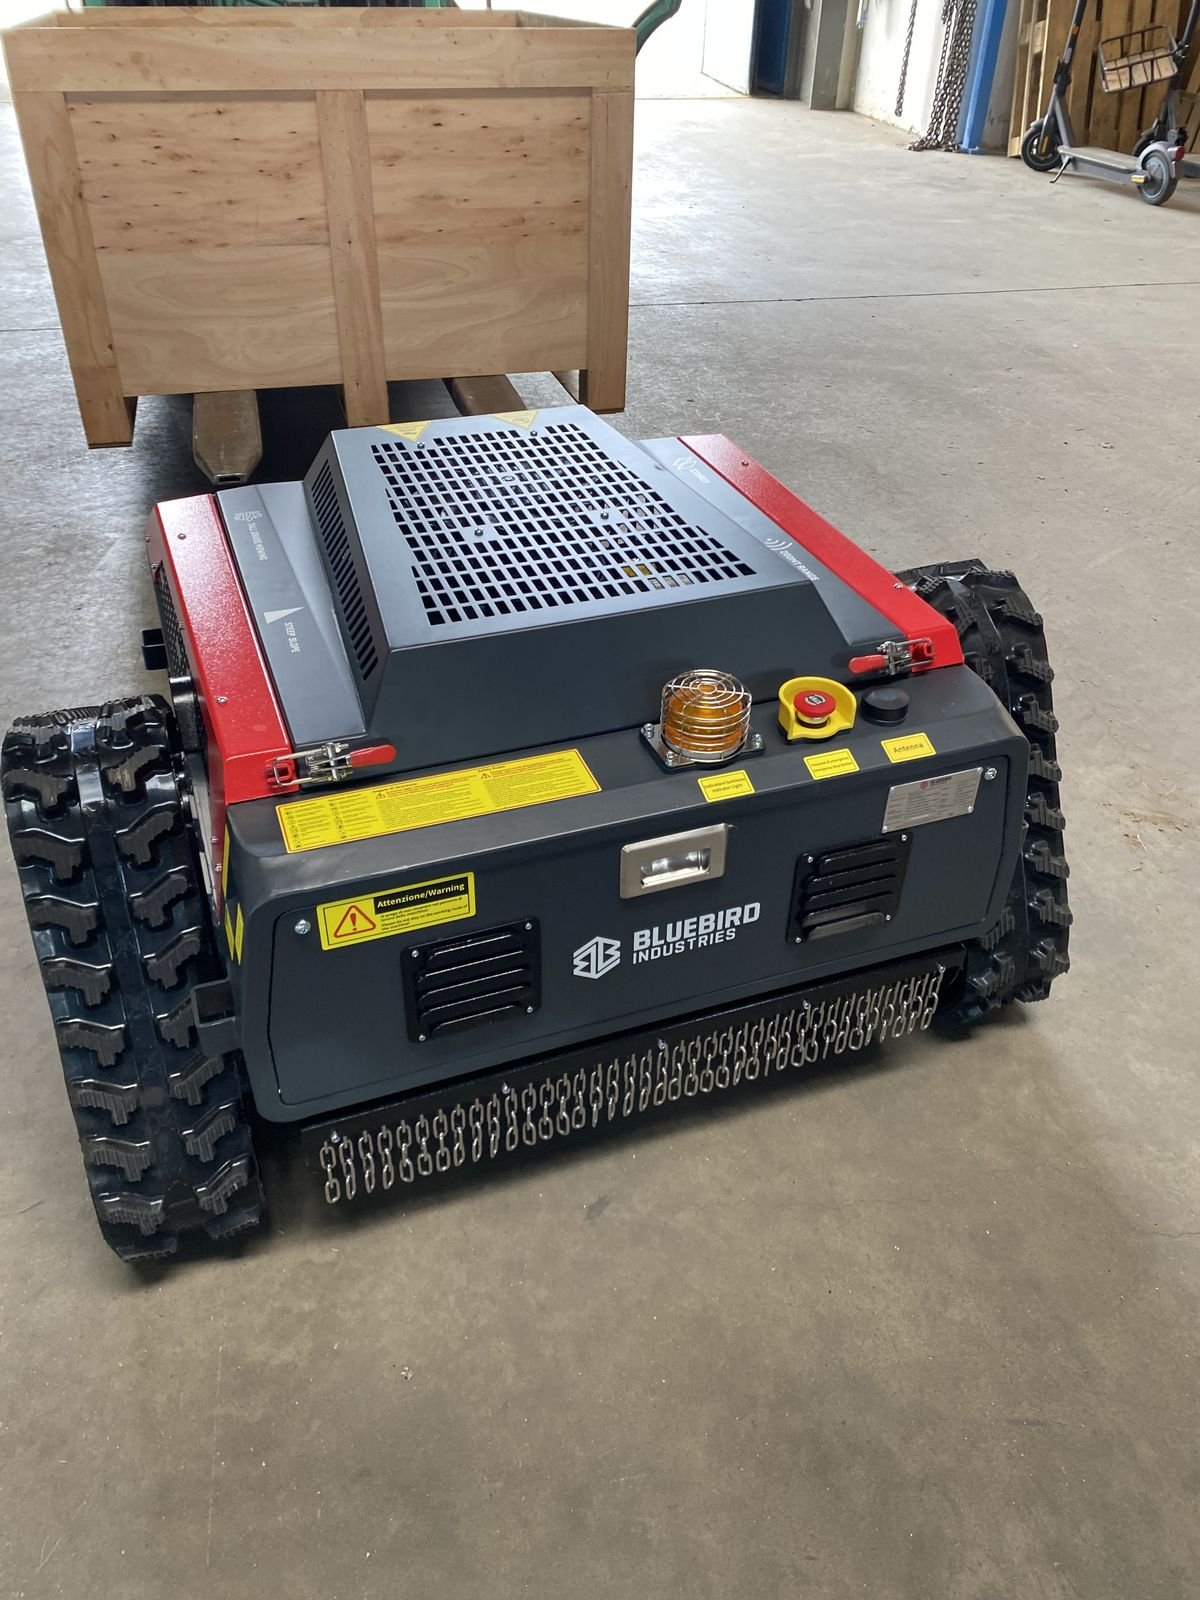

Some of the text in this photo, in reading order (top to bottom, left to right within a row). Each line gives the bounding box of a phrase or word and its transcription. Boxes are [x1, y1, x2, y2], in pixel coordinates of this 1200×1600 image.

[893, 743, 924, 754] Antenna
[377, 883, 465, 909] Attenzione/Warning
[633, 902, 761, 952] BLUEBIRD
[632, 928, 736, 965] INDUSTRIES
